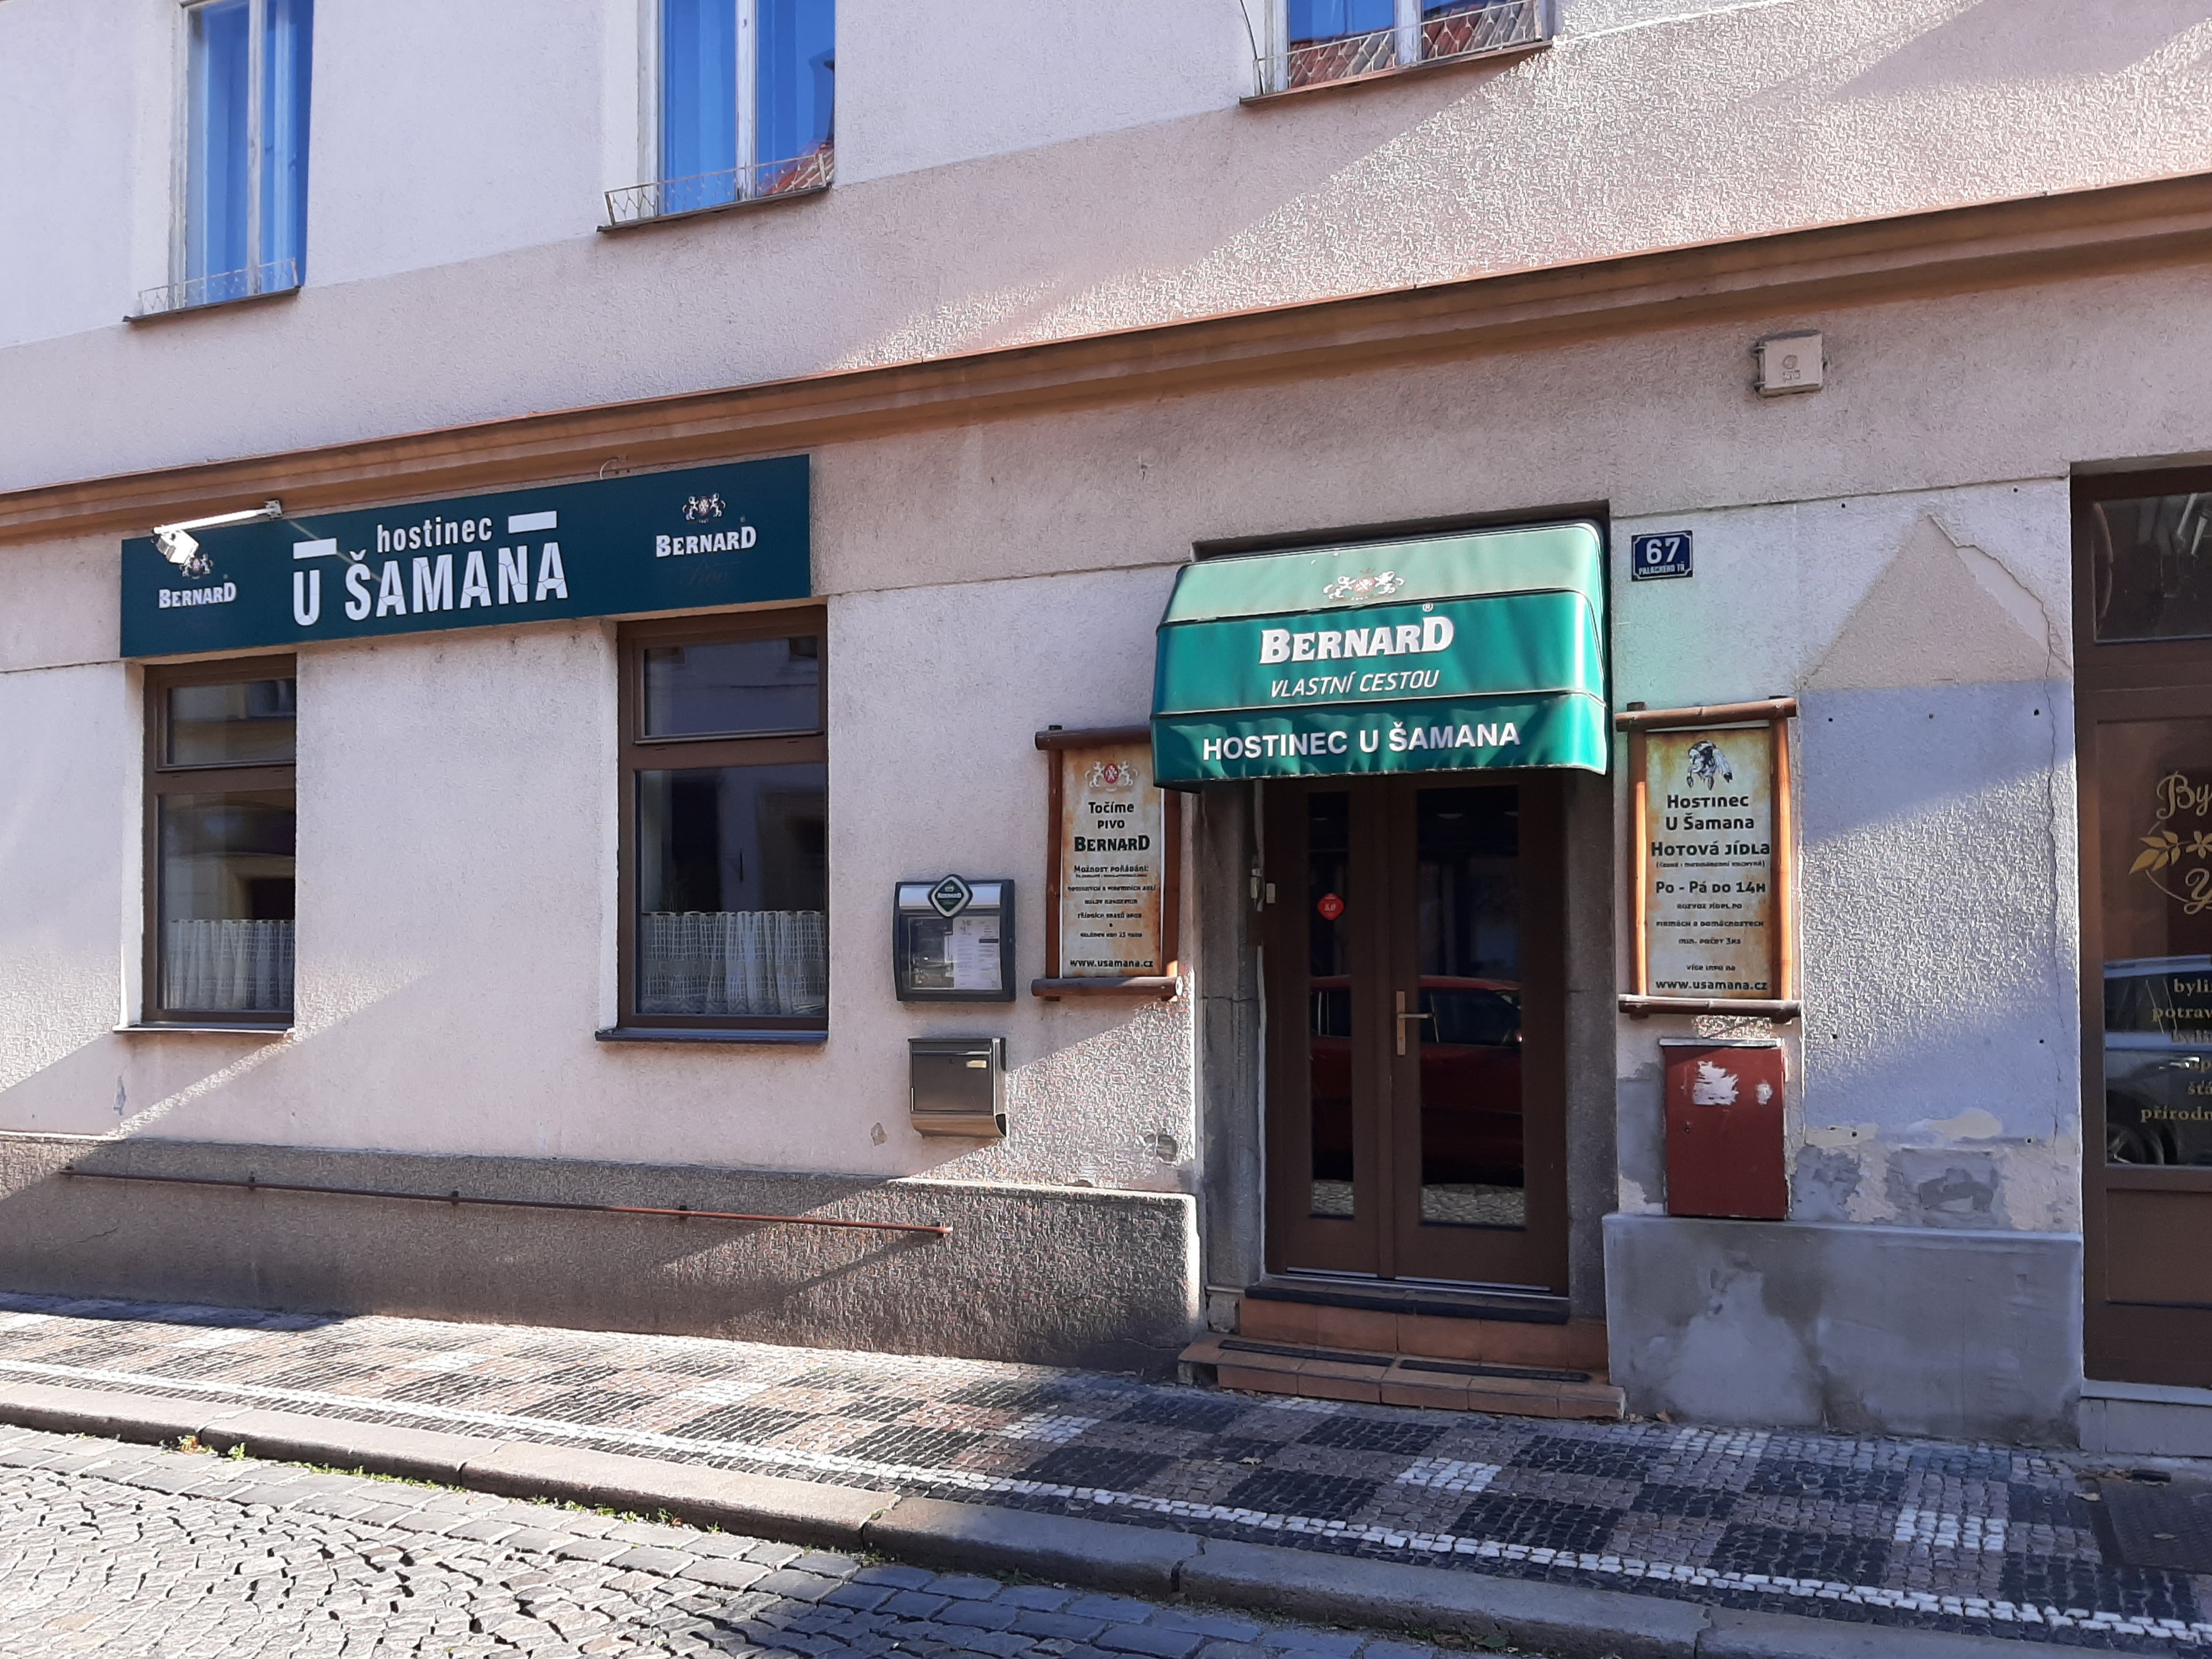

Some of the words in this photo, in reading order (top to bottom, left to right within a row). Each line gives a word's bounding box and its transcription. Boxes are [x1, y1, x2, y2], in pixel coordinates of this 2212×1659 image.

[377, 516, 492, 552] hostinec
[656, 525, 757, 558] BERNARD
[1646, 537, 1681, 564] 67
[158, 582, 236, 609] BERNARD
[293, 569, 319, 626] U
[345, 542, 568, 620] ŠAMANA
[1259, 616, 1454, 665] BERNARD
[1271, 670, 1355, 698] VLASTNÍ
[1359, 669, 1440, 693] CESTOU
[1202, 730, 1348, 761] HOSTINEC
[1359, 729, 1379, 753] U
[1388, 721, 1521, 753] ŠAMANA
[1088, 802, 1134, 814] Točíme
[1666, 817, 1678, 831] U
[1683, 813, 1754, 830] Šamana
[1074, 835, 1150, 852] BERNARD
[1656, 881, 1674, 893] Po
[1689, 881, 1707, 893] Pá
[1070, 960, 1153, 968] www.usamana.cz
[1656, 981, 1768, 990] www.usamana.cz
[2173, 978, 2212, 997] byli
